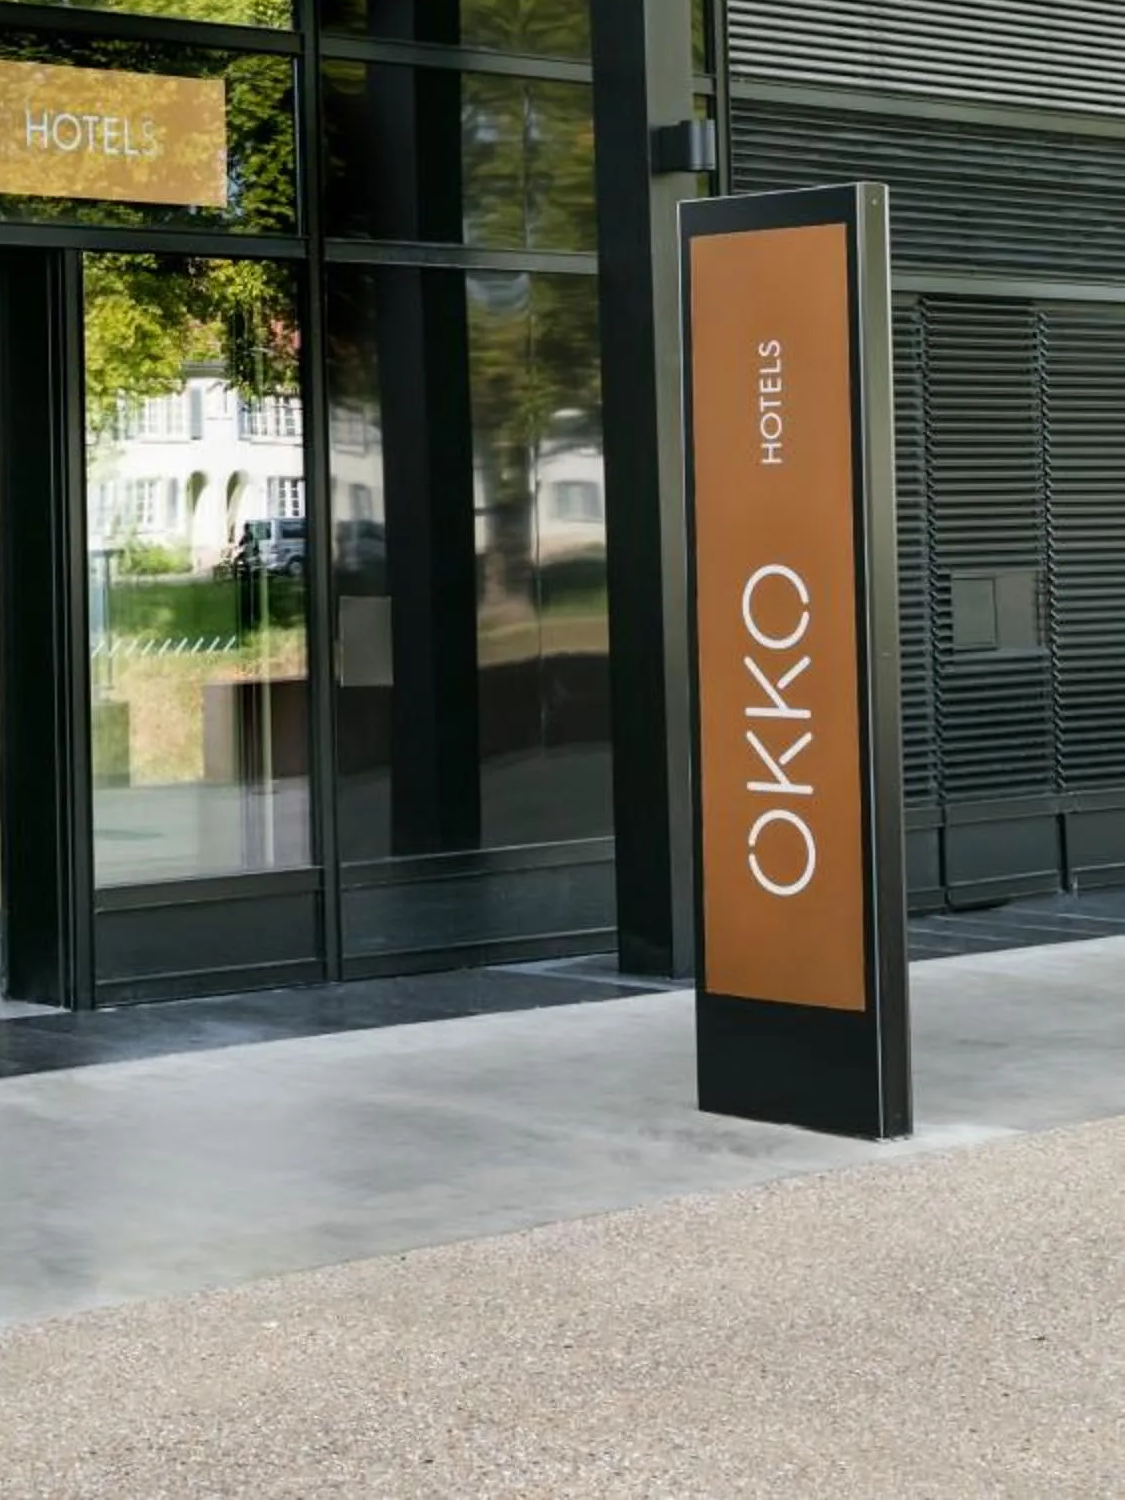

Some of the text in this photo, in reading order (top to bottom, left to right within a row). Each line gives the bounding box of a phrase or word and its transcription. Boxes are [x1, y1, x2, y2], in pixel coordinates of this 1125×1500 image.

[25, 108, 158, 161] HOTELS
[742, 339, 816, 896] OKKO HOTELS
